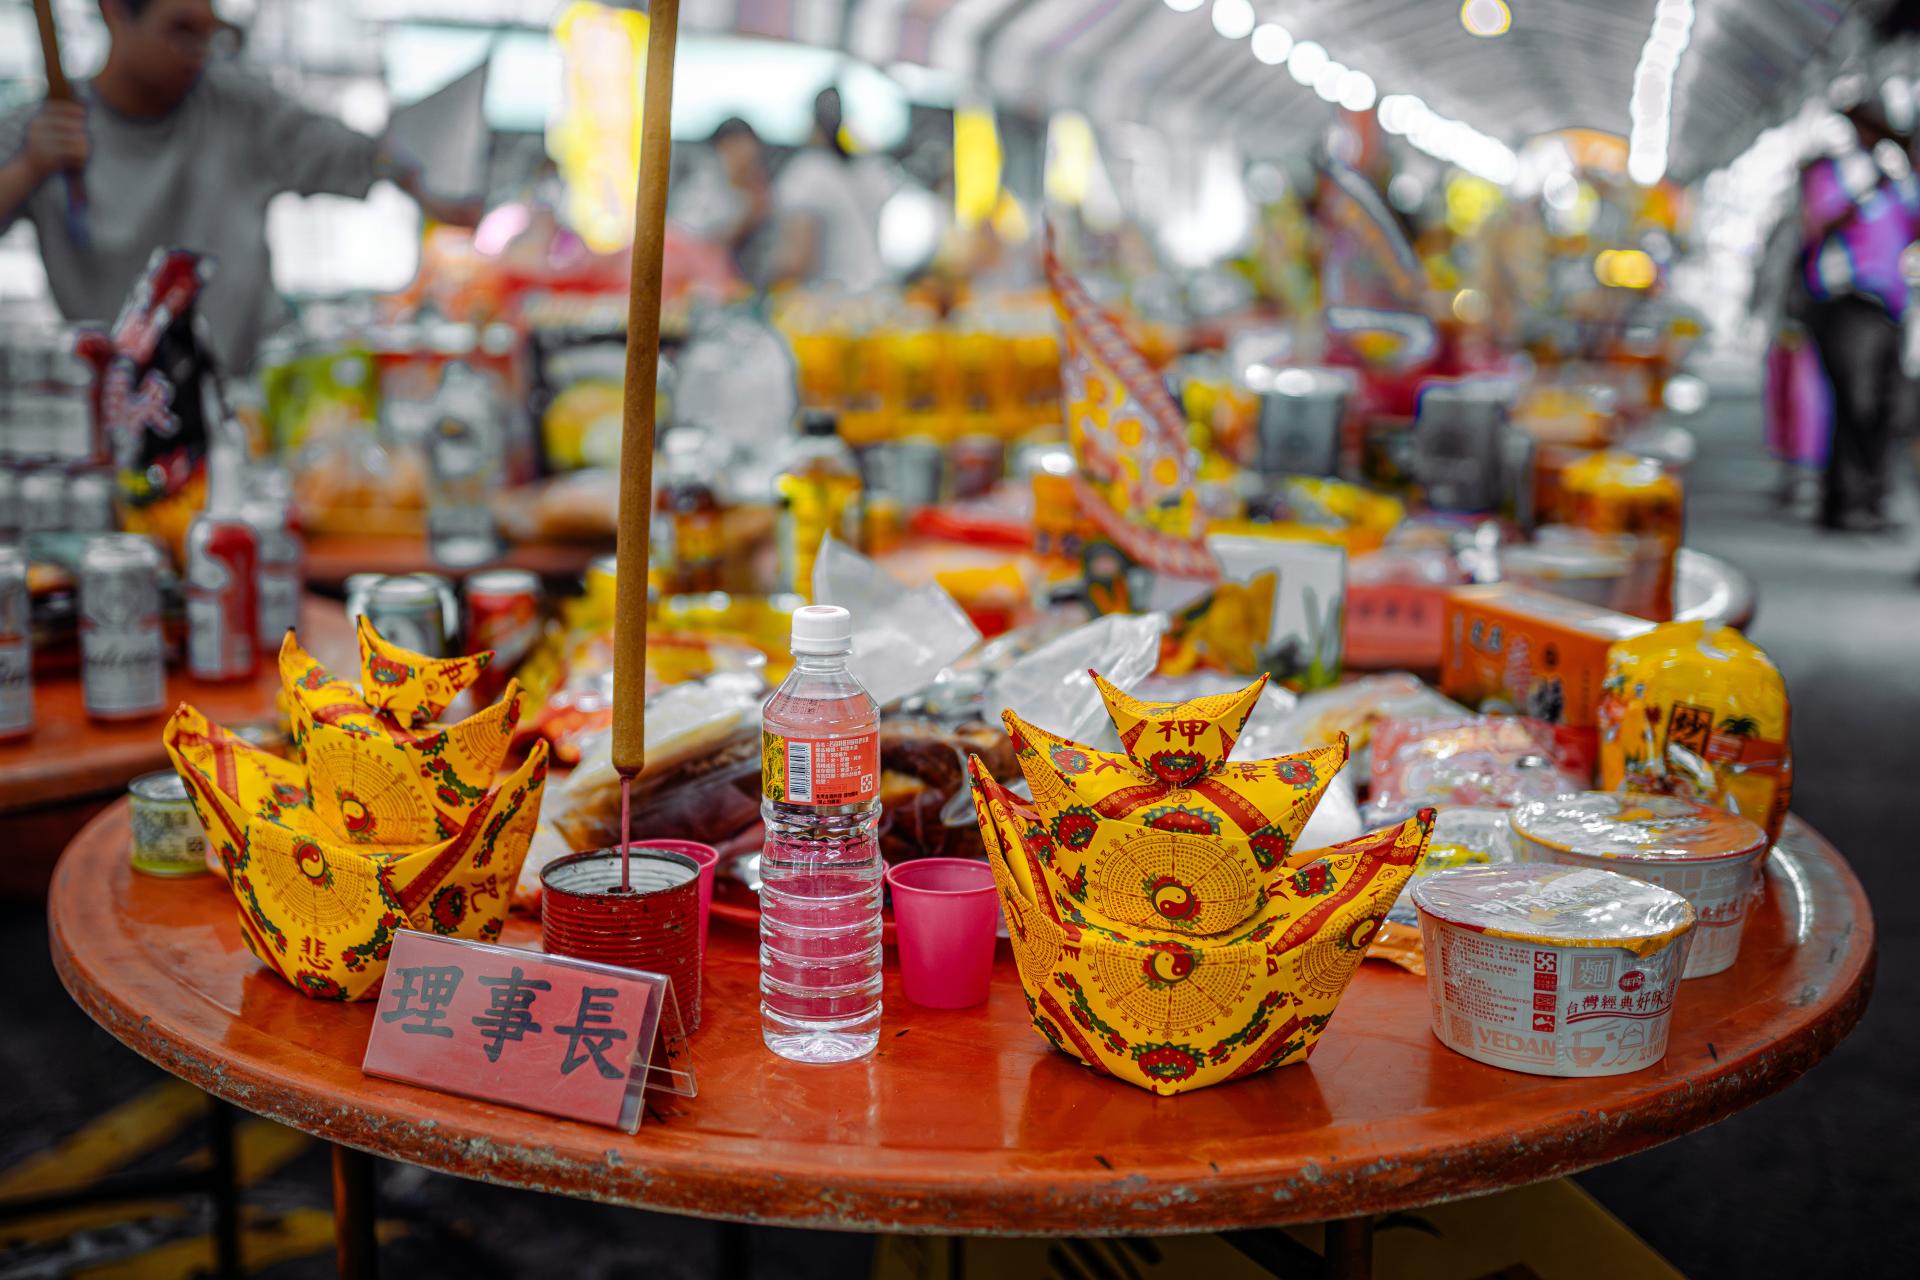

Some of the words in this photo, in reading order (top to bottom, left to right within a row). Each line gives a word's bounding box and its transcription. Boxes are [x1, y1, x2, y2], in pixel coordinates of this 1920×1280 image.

[1156, 719, 1211, 747] 神
[298, 936, 333, 971] 悲
[1579, 958, 1611, 986] 麵
[381, 965, 627, 1079] 理事長
[1477, 1026, 1556, 1057] VEDAN
